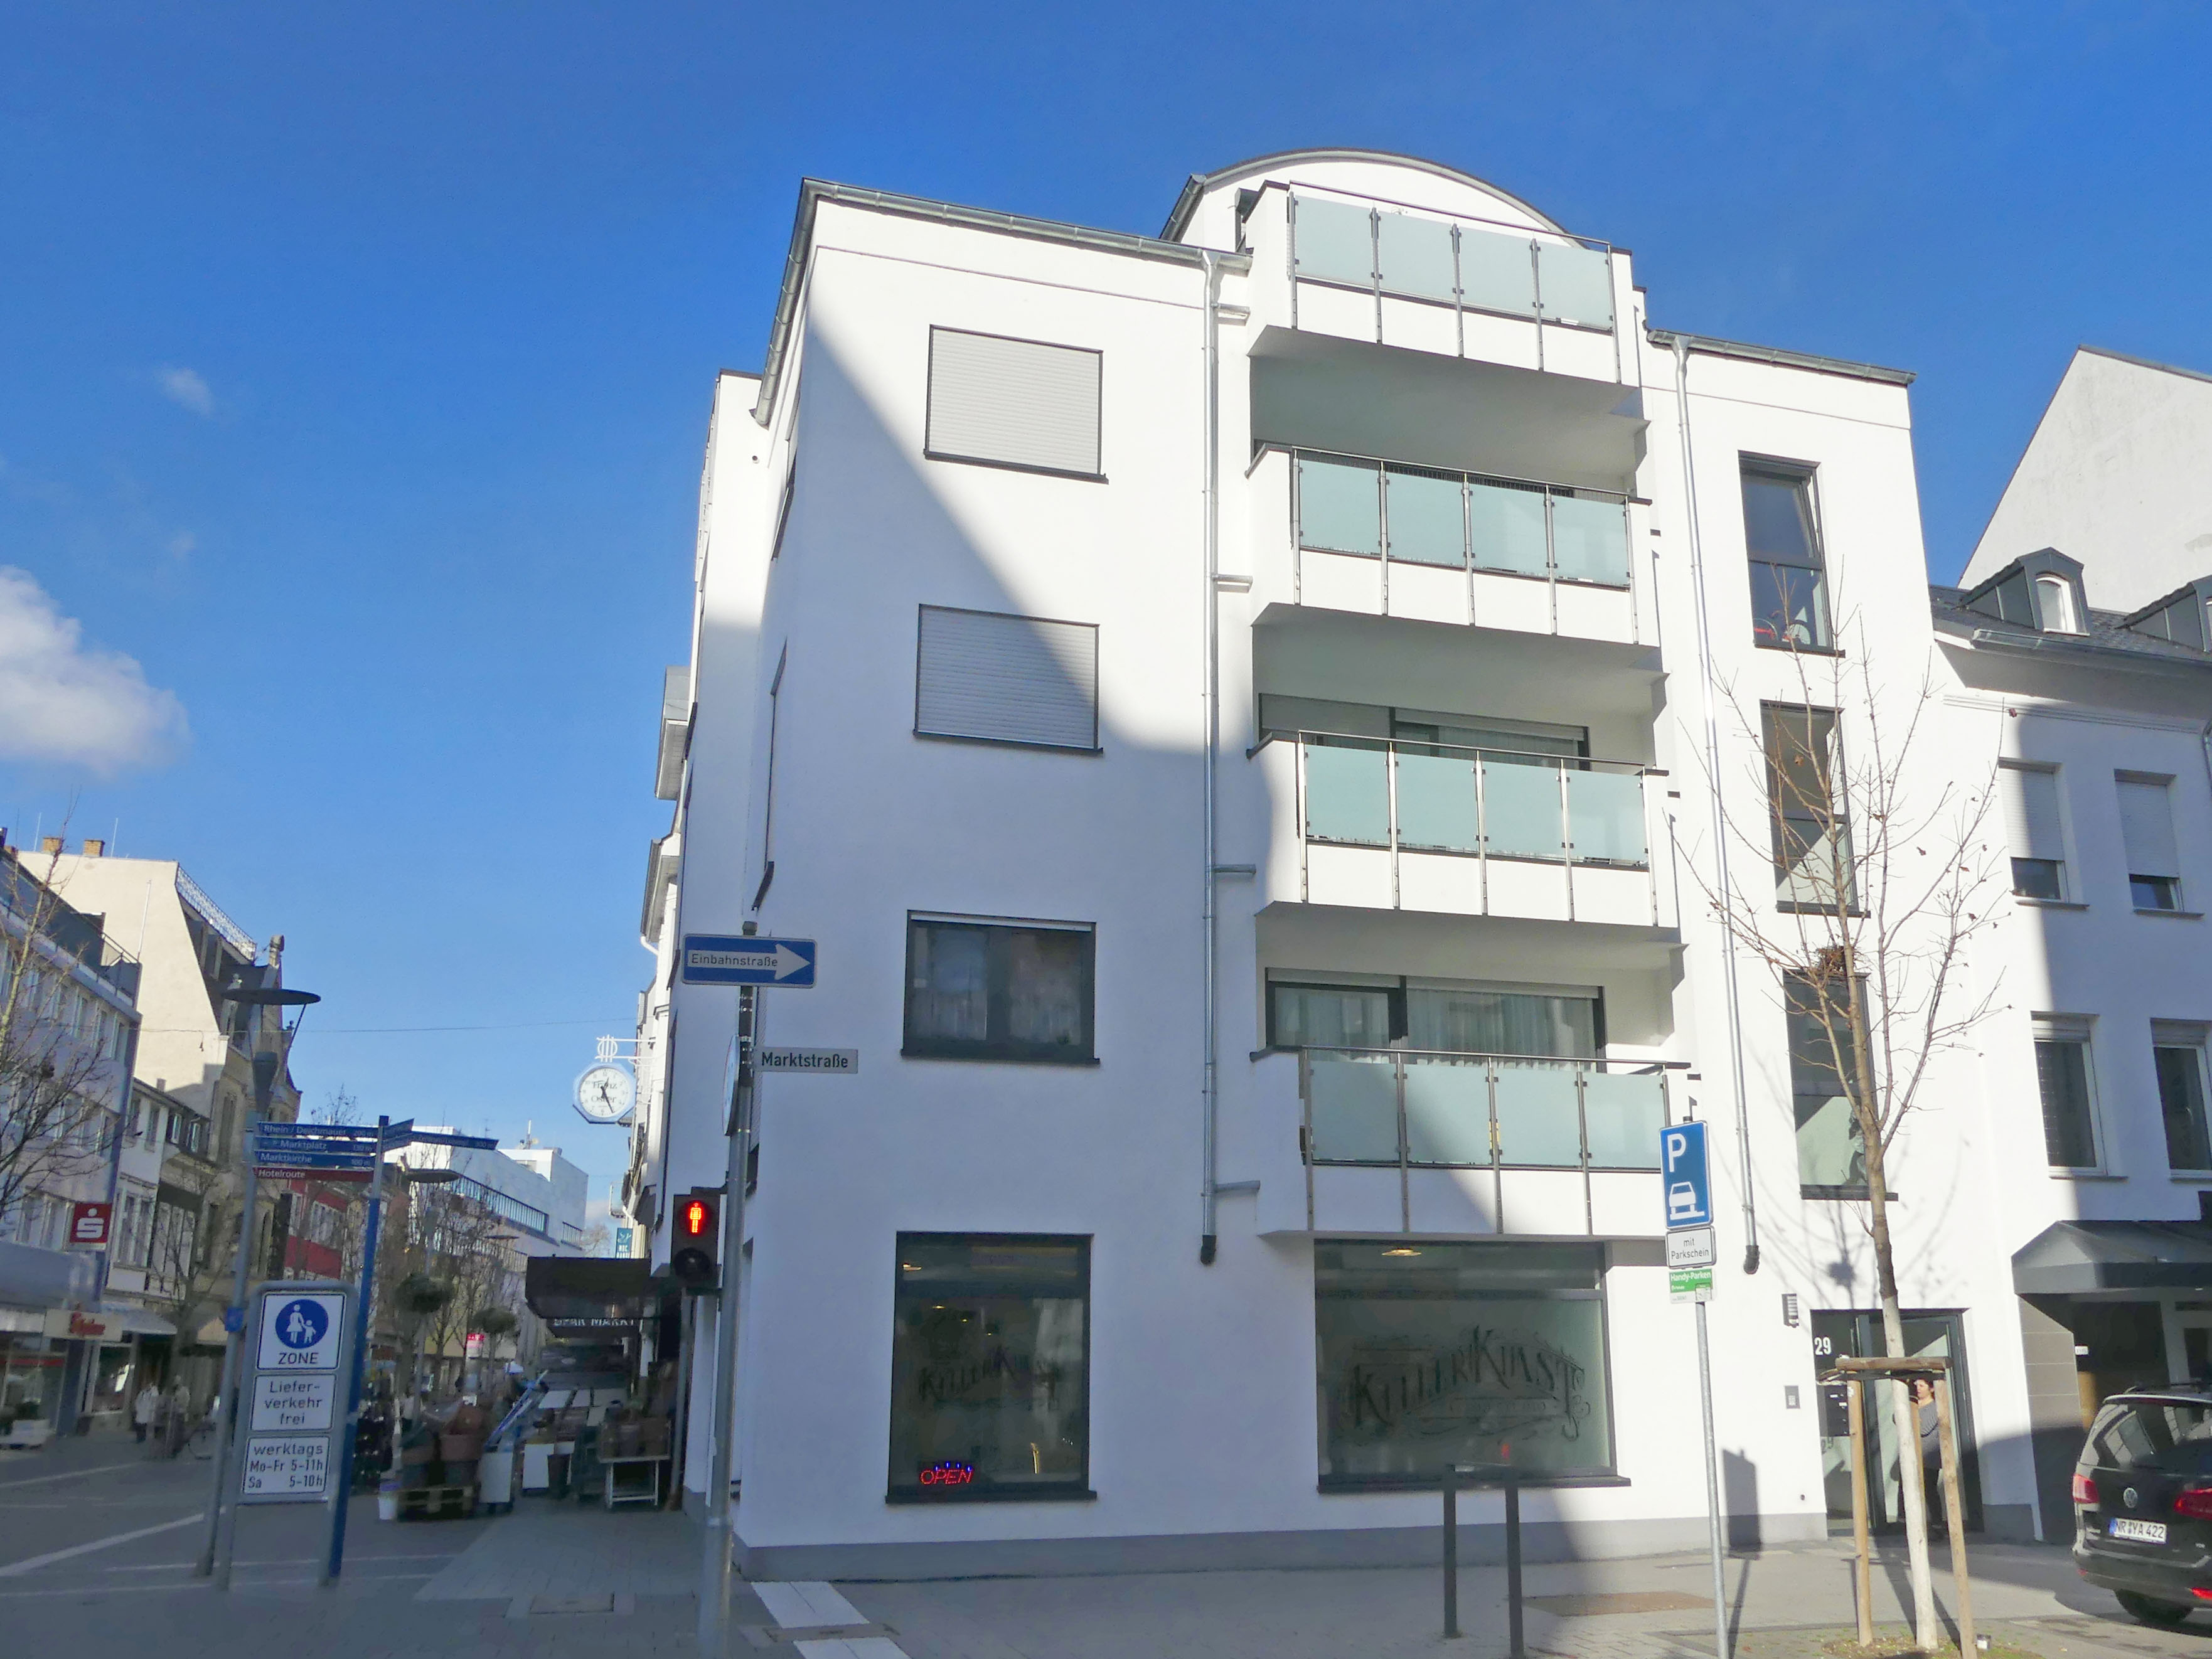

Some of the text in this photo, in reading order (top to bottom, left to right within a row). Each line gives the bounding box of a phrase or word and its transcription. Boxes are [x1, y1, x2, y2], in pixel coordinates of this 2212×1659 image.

[692, 953, 778, 967] Einbahnstraße
[761, 1052, 848, 1068] Marktstraße
[264, 1125, 289, 1133] Rhein
[296, 1126, 346, 1135] Deichmauer
[280, 1139, 328, 1150] Marktplatz
[260, 1153, 313, 1163] Marktkirche
[1667, 1133, 1686, 1172] P
[258, 1169, 306, 1178] Hotelroute
[1683, 1237, 1695, 1247] mit
[1671, 1247, 1709, 1259] Parkschein
[1670, 1271, 1711, 1283] Handy-Parken
[1814, 1336, 1832, 1355] 29
[278, 1352, 319, 1365] ZONE
[270, 1380, 320, 1393] Liefer-
[265, 1397, 323, 1409] verkehr
[281, 1412, 305, 1424] frei
[254, 1443, 323, 1458] werktags
[250, 1459, 285, 1473] Mo-Fr
[248, 1476, 262, 1488] Sa
[920, 1468, 973, 1485] OPEN
[2117, 1520, 2164, 1539] NR YA 422
